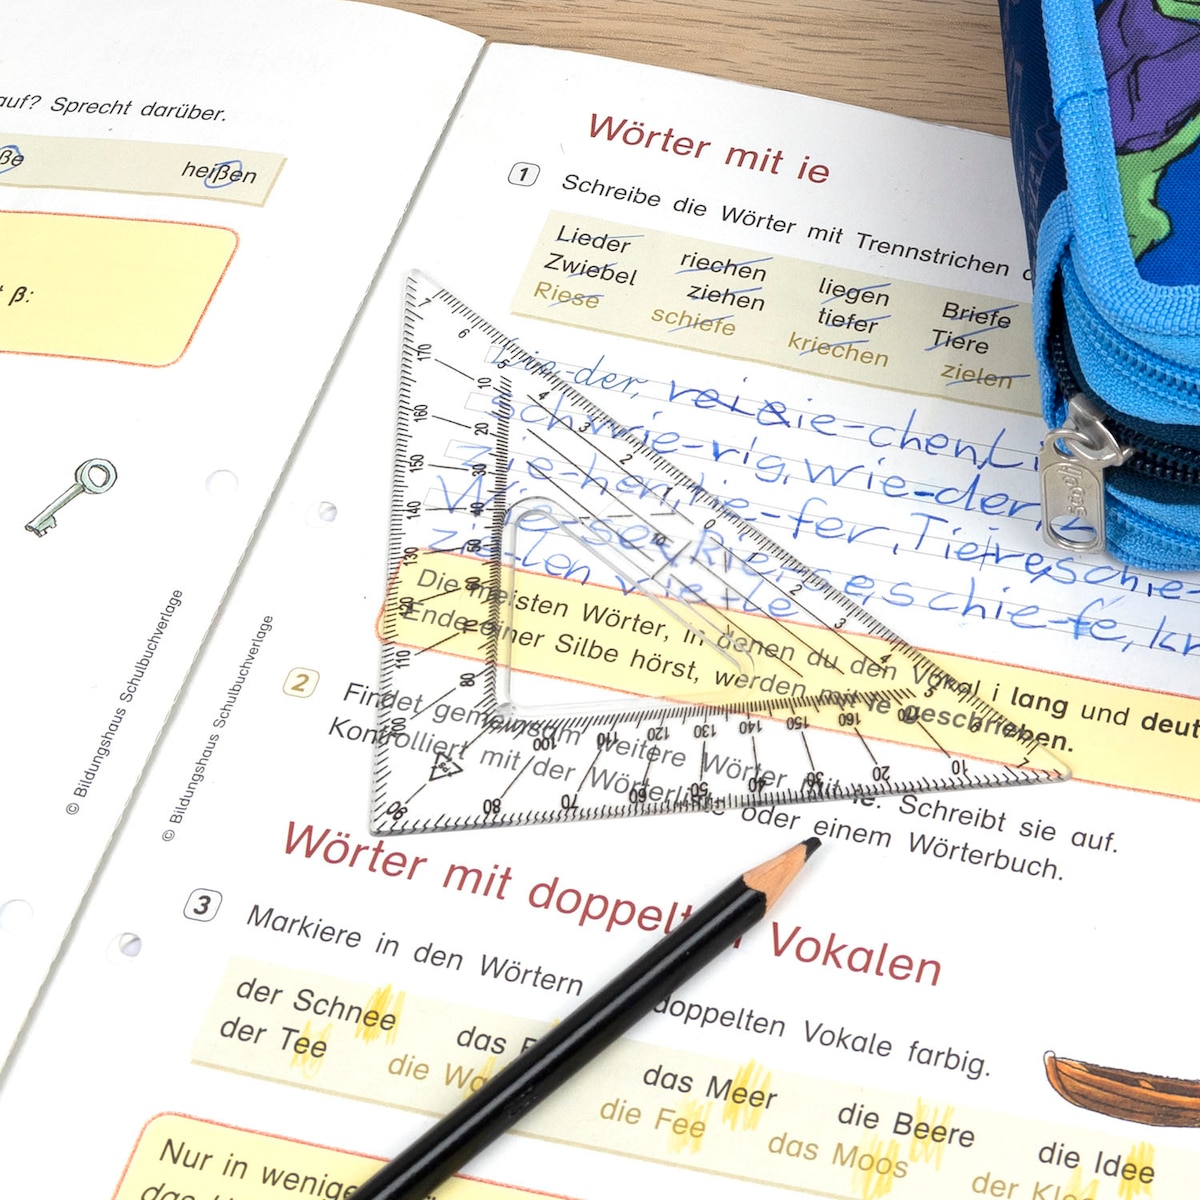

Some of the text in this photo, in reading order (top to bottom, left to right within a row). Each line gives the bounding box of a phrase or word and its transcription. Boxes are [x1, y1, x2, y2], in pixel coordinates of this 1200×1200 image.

[50, 96, 132, 118] Sprecht
[140, 101, 228, 122] darüber.
[589, 113, 830, 184] Wörter mit ie
[181, 161, 257, 185] heißen
[519, 167, 529, 182] 1
[562, 174, 661, 207] Schreibe
[673, 197, 707, 217] die
[722, 205, 797, 234] Wörter
[807, 226, 844, 244] mit
[857, 232, 1009, 277] Trennstrichen
[557, 225, 1011, 329] Lieder riechen liegen Briefe
[544, 253, 989, 354] Zwiebel ziehen tiefer Tiere
[533, 282, 1013, 390] Riese schiefe kriechen zielen
[413, 404, 428, 423] 160
[474, 422, 489, 436] 20
[409, 454, 425, 473] 150
[406, 501, 422, 520] 140
[619, 454, 633, 466] 2
[703, 519, 716, 530] 0
[789, 584, 803, 596] 2
[834, 618, 847, 629] 3
[417, 568, 459, 592] Die
[469, 583, 569, 618] meisten
[582, 602, 669, 642] Wörter,
[683, 622, 706, 646] in
[717, 630, 795, 662] denen
[807, 649, 838, 670] du
[850, 656, 897, 680] den
[992, 683, 1000, 702] i
[1011, 686, 1069, 719] lang
[1080, 704, 1130, 726] und
[73, 589, 183, 798] Bildungshaus Schulbuchverlage
[403, 601, 466, 631] Ende
[480, 620, 546, 648] einer
[555, 633, 619, 663] Silbe
[630, 648, 699, 684] hörst,
[715, 670, 806, 699] werden
[904, 704, 1074, 753] geschrieben.
[460, 672, 476, 687] 80
[169, 615, 273, 824] Bildungshaus Schulbuchverlage
[533, 712, 862, 751] 100 120 130 140 150 160
[291, 673, 310, 693] 2
[343, 682, 424, 714] Findet
[703, 751, 788, 789] Wörter
[899, 794, 1006, 832] Schreibt
[1019, 819, 1056, 841] sie
[1071, 830, 1118, 853] auf.
[872, 765, 890, 782] 20
[951, 760, 968, 775] 10
[328, 716, 468, 760] Kontrolliert
[480, 749, 521, 771] mit
[532, 757, 576, 782] der
[741, 804, 800, 830] oder
[813, 817, 892, 848] einem
[908, 831, 1064, 881] Wörterbuch.
[483, 798, 501, 815] 80
[561, 793, 578, 810] 70
[284, 821, 428, 881] Wörter
[443, 863, 512, 900] mit
[771, 921, 942, 987] Vokalen
[192, 895, 212, 915] 3
[247, 904, 362, 948] Markiere
[375, 933, 399, 957] in
[413, 942, 463, 971] den
[480, 954, 583, 997] Wörtern
[805, 1019, 893, 1058] Vokale
[908, 1040, 991, 1080] farbig.
[236, 977, 397, 1032] der Schnee
[220, 1016, 328, 1059] der Tee
[457, 1025, 507, 1055] das
[387, 1053, 429, 1081] die
[642, 1064, 778, 1110] das Meer
[599, 1098, 707, 1139] die Fee
[838, 1102, 975, 1149] die Beere
[159, 1138, 213, 1171] Nur
[222, 1152, 248, 1179] in
[767, 1132, 909, 1180] das Moos
[1038, 1141, 1156, 1186] die Idee
[971, 1171, 1019, 1200] der
